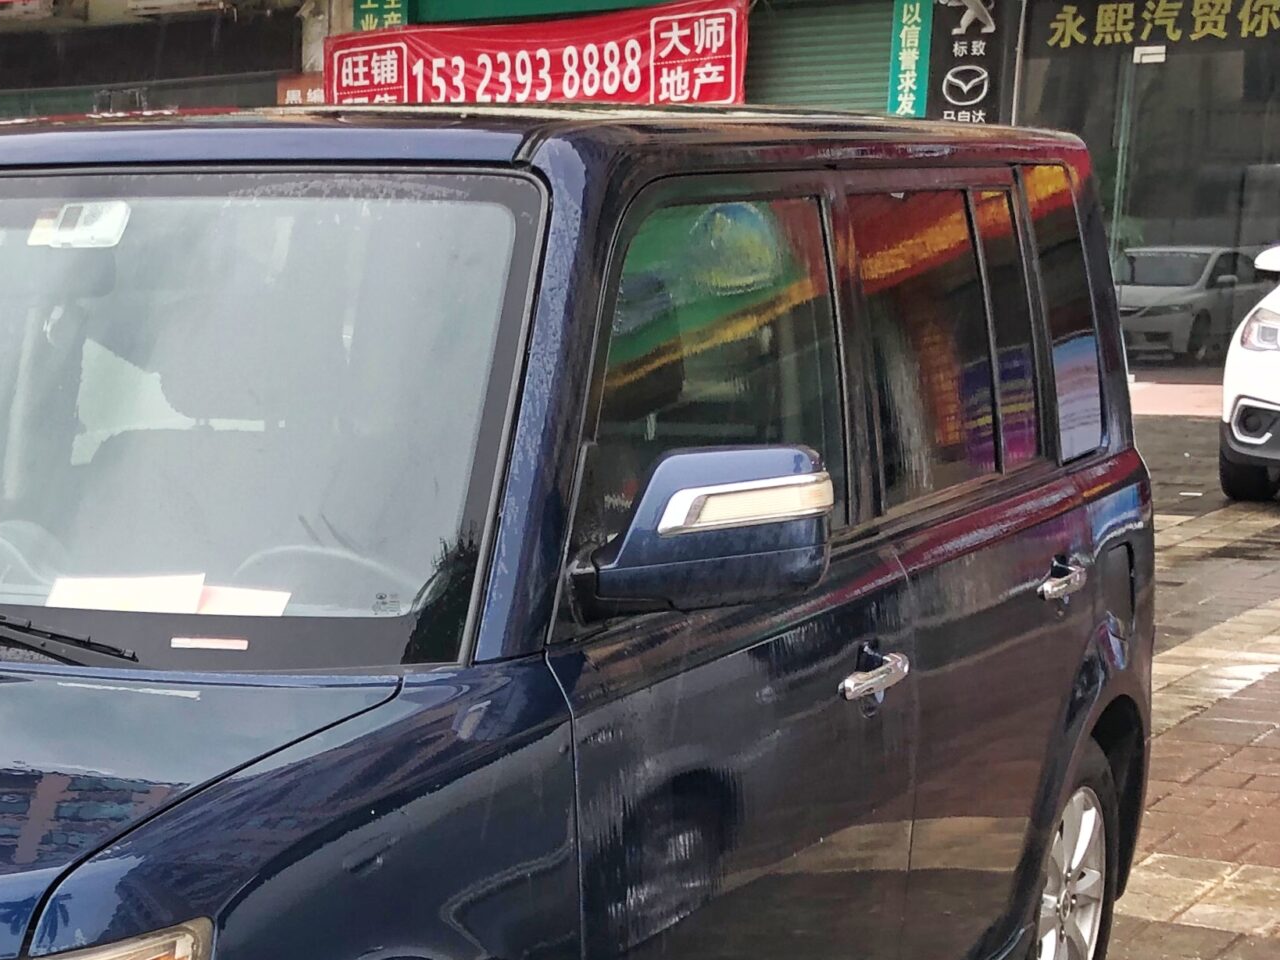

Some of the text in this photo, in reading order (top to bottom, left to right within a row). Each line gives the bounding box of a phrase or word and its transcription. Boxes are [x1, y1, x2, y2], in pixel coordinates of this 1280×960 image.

[659, 17, 726, 58] 大师
[952, 40, 986, 57] 标致
[342, 50, 398, 87] 旺铺
[412, 39, 642, 103] 153 2393 8888
[896, 2, 921, 116] 以信誉求发
[658, 62, 725, 102] 地产
